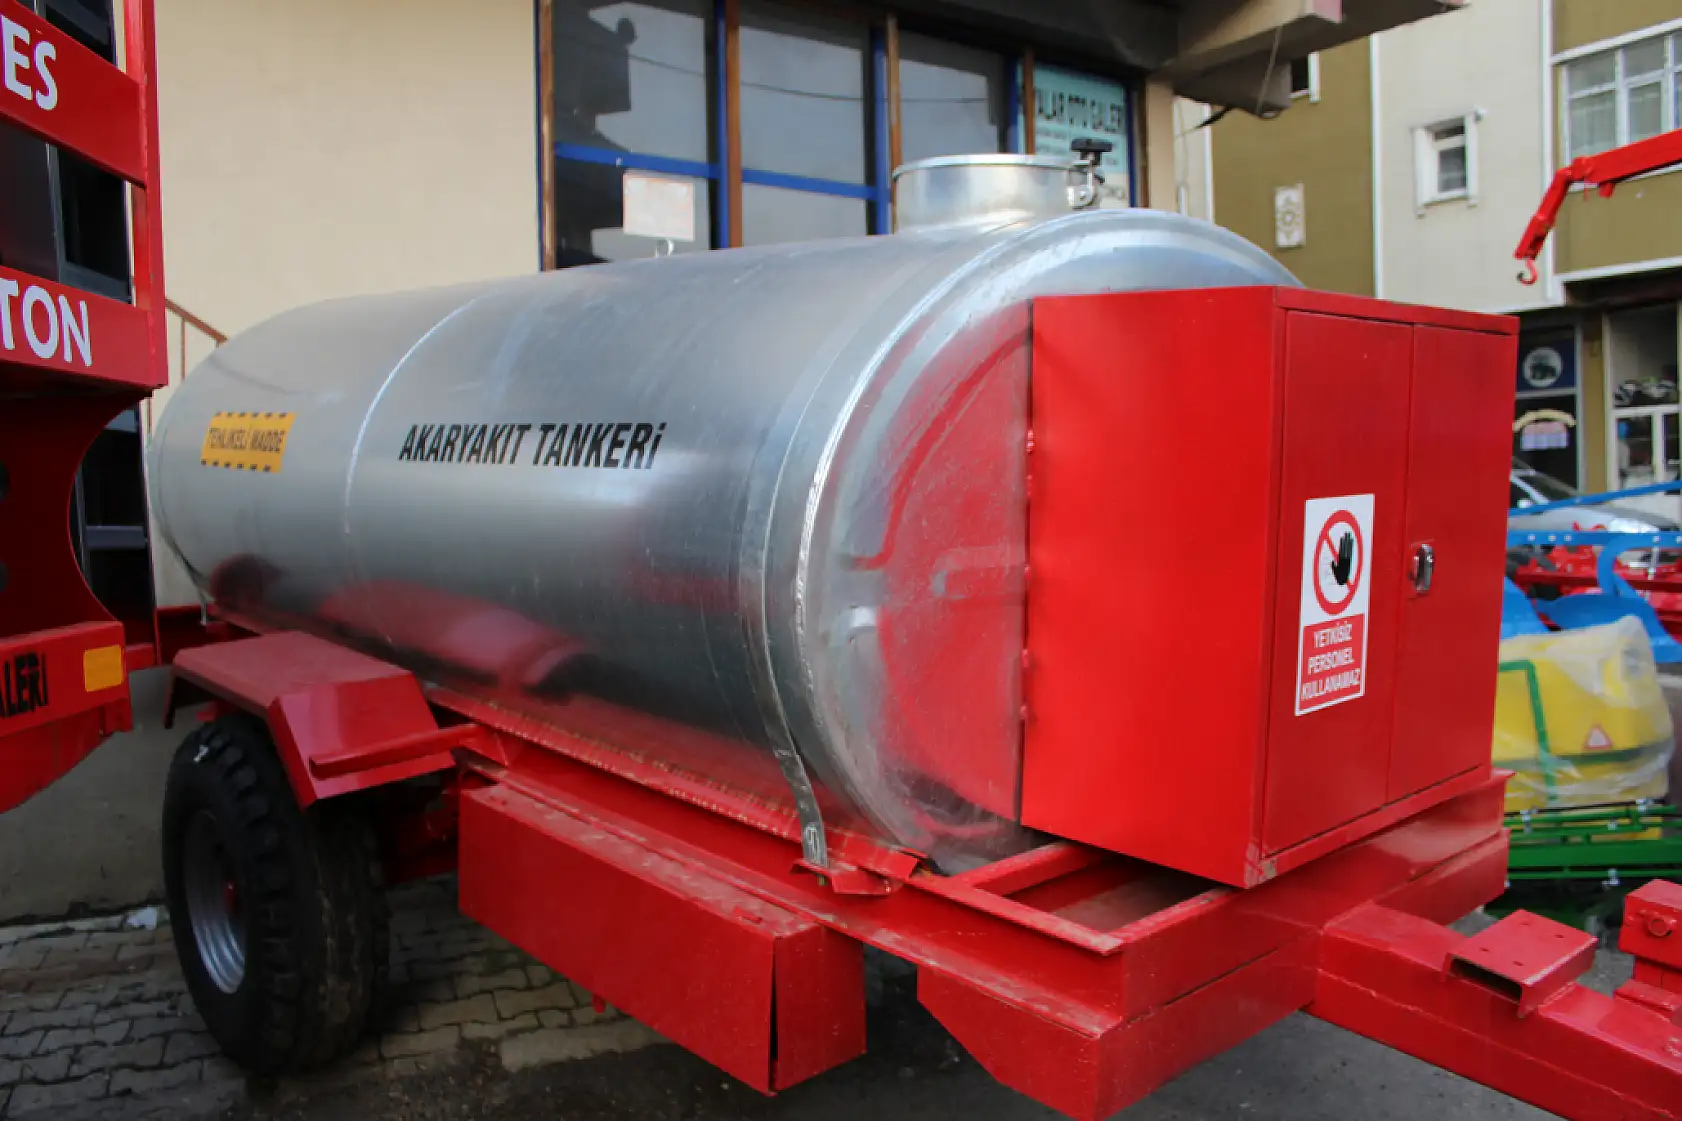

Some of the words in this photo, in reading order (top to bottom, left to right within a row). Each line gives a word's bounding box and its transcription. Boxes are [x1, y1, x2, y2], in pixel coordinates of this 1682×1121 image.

[1, 14, 58, 111] ES
[0, 277, 92, 367] TON
[399, 422, 532, 465] AKARYAKIT
[1308, 648, 1354, 675] PERSONEL
[1301, 669, 1360, 700] KULLANAMAZ
